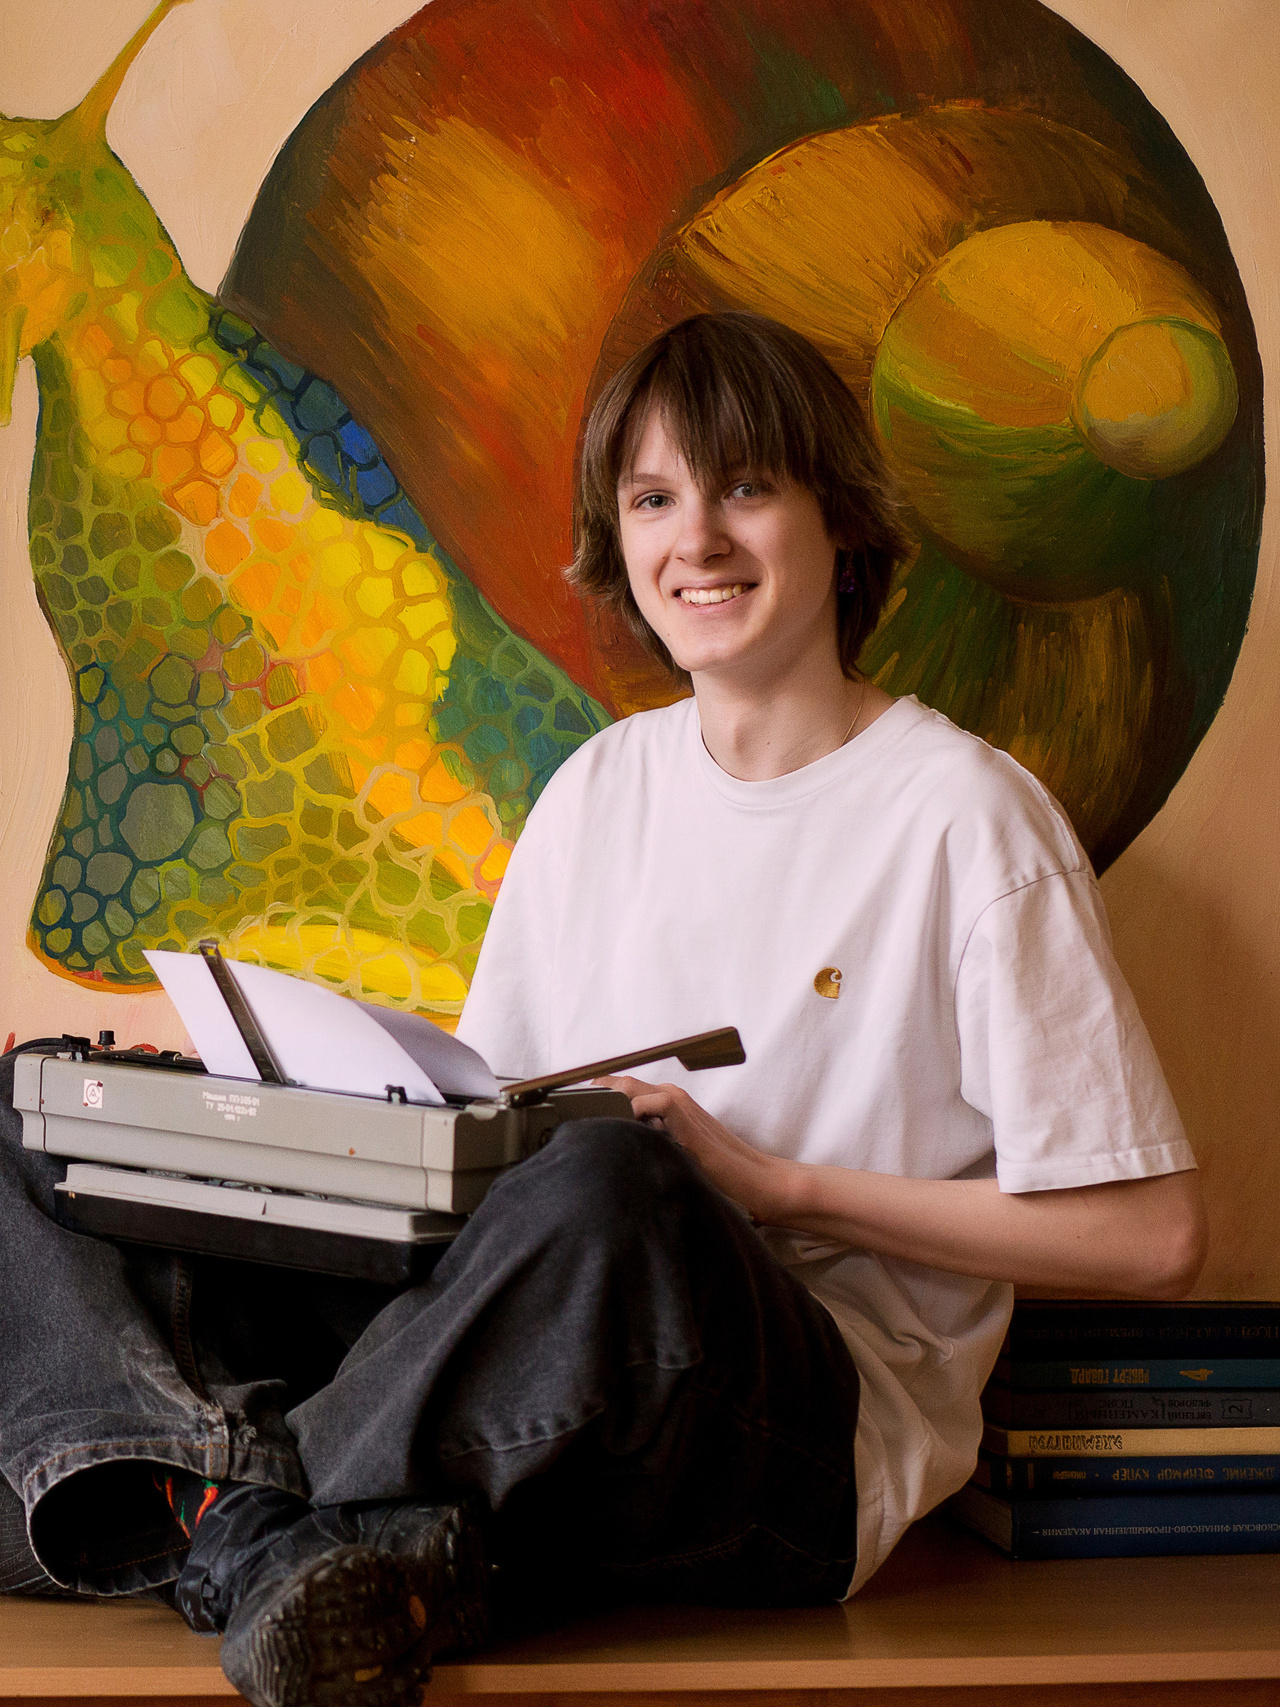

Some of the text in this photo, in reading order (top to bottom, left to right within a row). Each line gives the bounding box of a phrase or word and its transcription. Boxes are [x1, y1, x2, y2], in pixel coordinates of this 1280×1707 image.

[1070, 1368, 1150, 1384] РОБЕРТ ГОВАРД
[1098, 1399, 1134, 1409] ПОЯС
[1168, 1400, 1211, 1408] ФЕДОРОВ
[1228, 1403, 1243, 1414] 2
[1073, 1408, 1159, 1421] КАМЕННЫЙ
[1168, 1410, 1212, 1420] ЕВГЕНИЙ
[1053, 1466, 1275, 1481] ДЖЕЙМС ФЕНИМОР КУПЕР ПИОНЕРЫ
[1042, 1522, 1280, 1537] СКОВСКАЯ ФИНАНСОВО-ПРОМЫШЛЕННАЯ АКАДЕМИЯ
